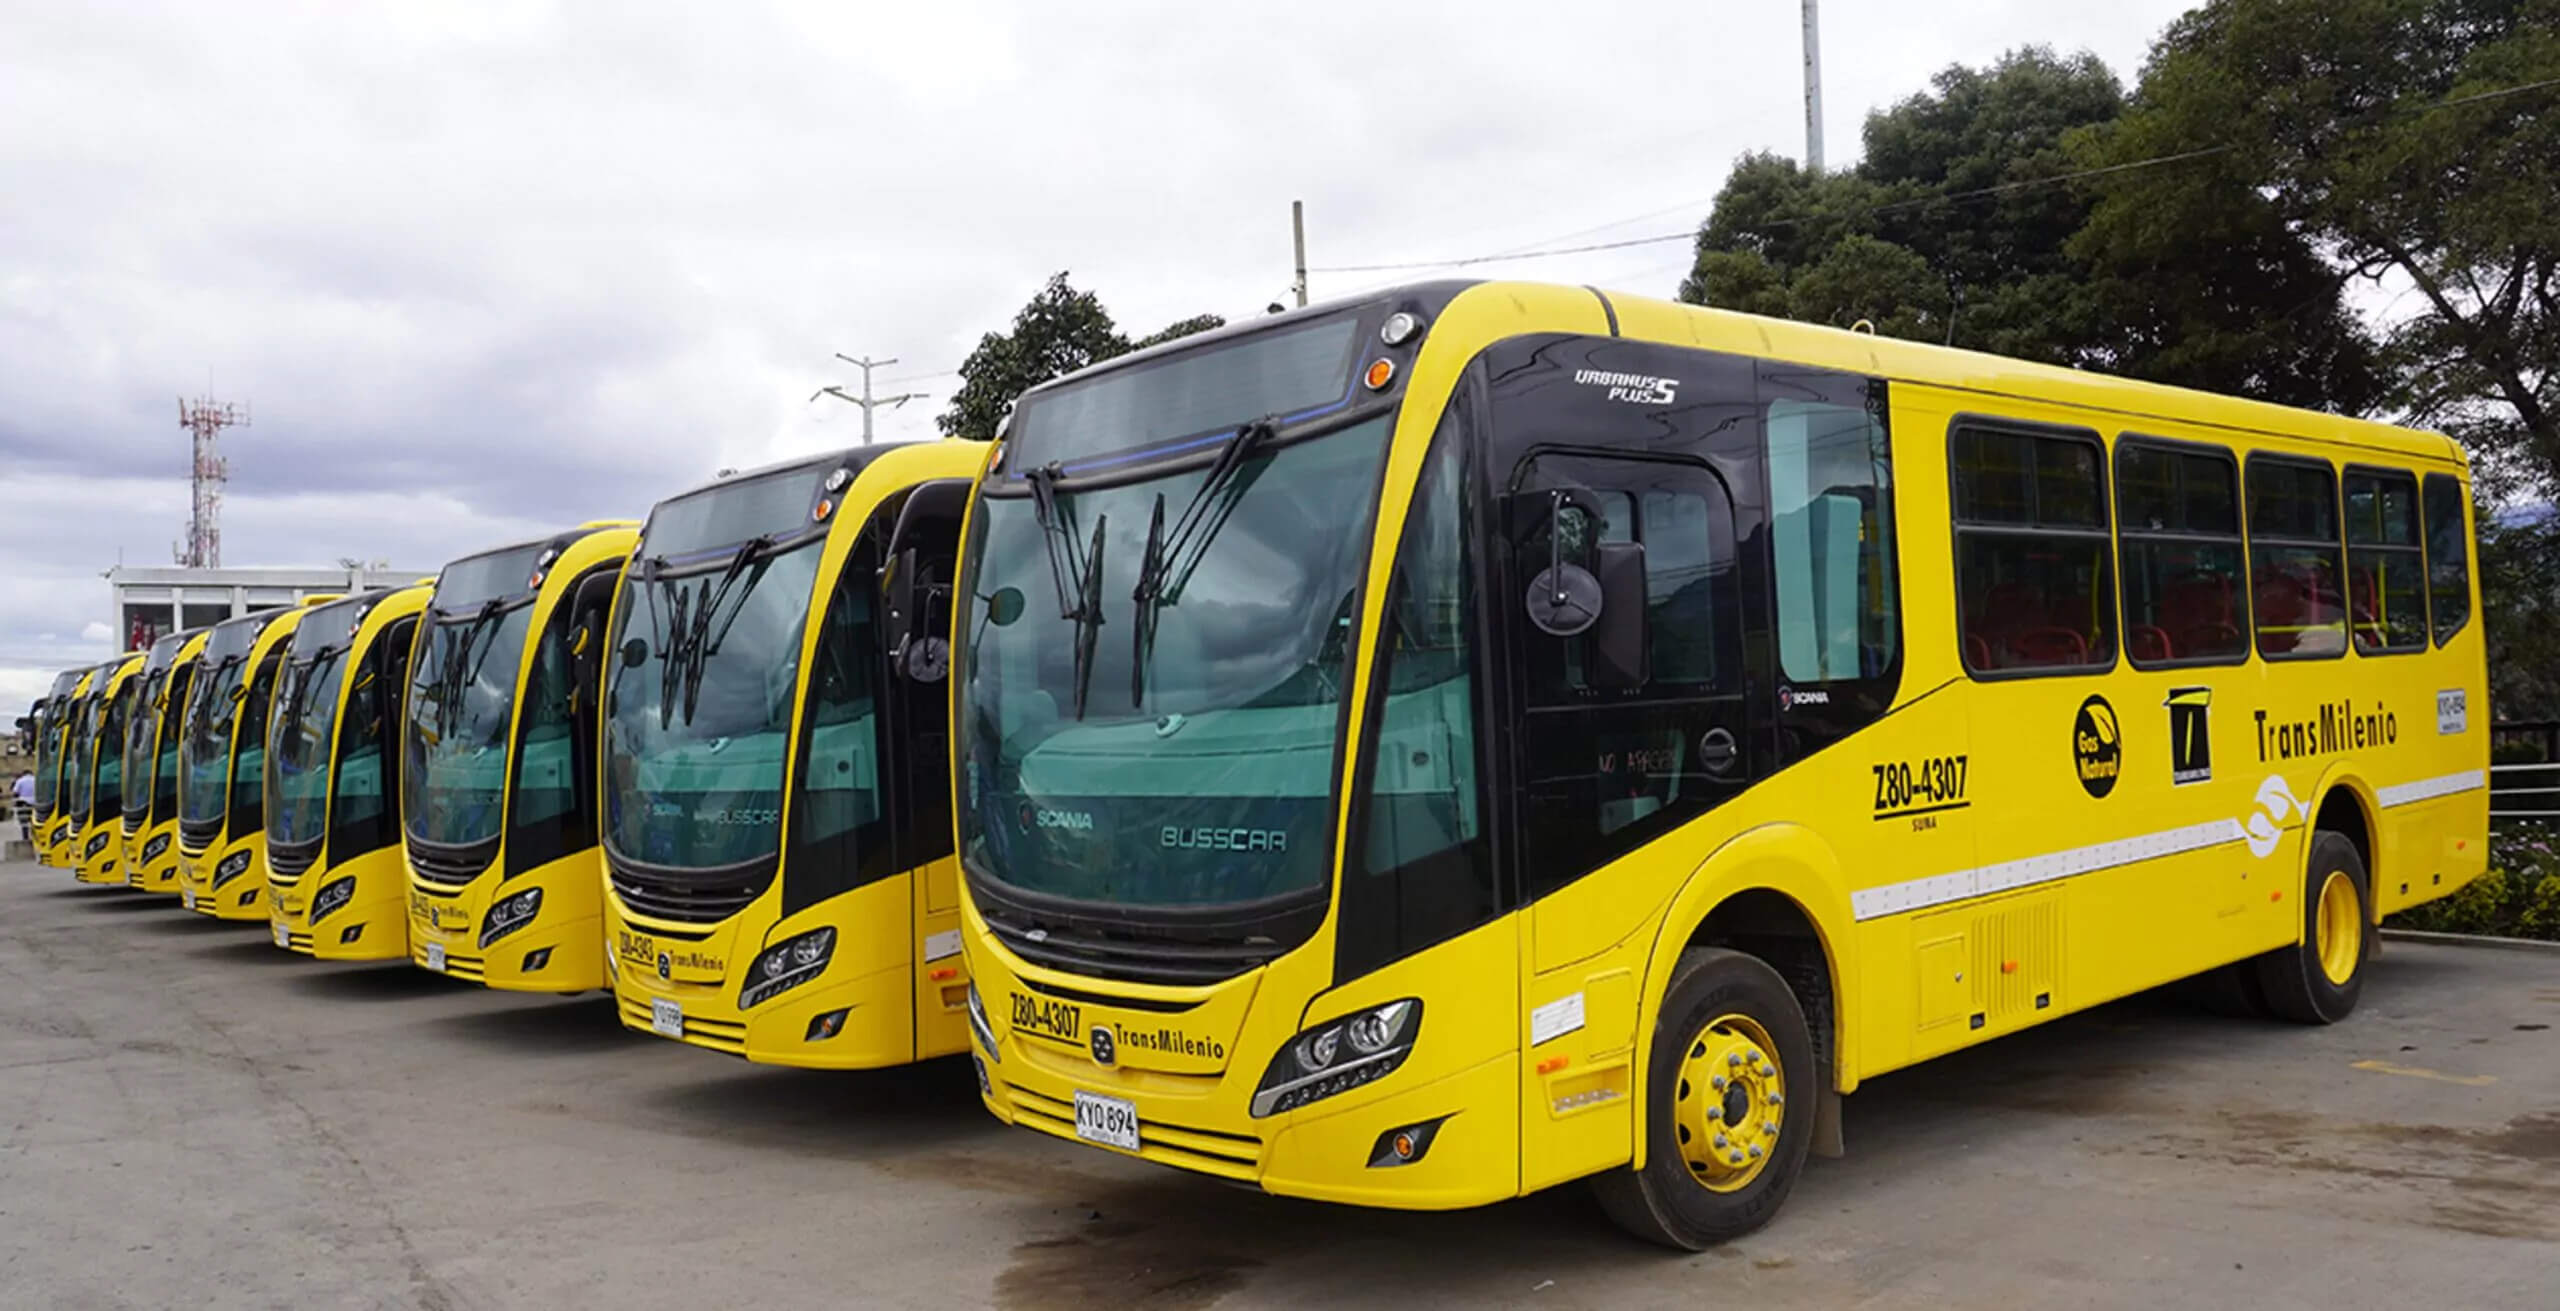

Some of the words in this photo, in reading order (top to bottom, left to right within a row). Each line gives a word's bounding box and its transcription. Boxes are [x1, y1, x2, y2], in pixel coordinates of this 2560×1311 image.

[1608, 386, 1653, 403] PLUS
[1793, 691, 1830, 705] SCANIA
[2079, 730, 2099, 754] Gas
[2254, 698, 2397, 763] TransMilenio
[2080, 752, 2118, 781] Natural
[1872, 755, 1968, 811] Z80-4307
[1036, 809, 1093, 830] SCANIA
[1160, 825, 1287, 852] BUSSCAR
[1009, 991, 1081, 1039] Z80-4307
[1113, 1022, 1225, 1059] TransMilenio
[1107, 1105, 1135, 1137] 894
